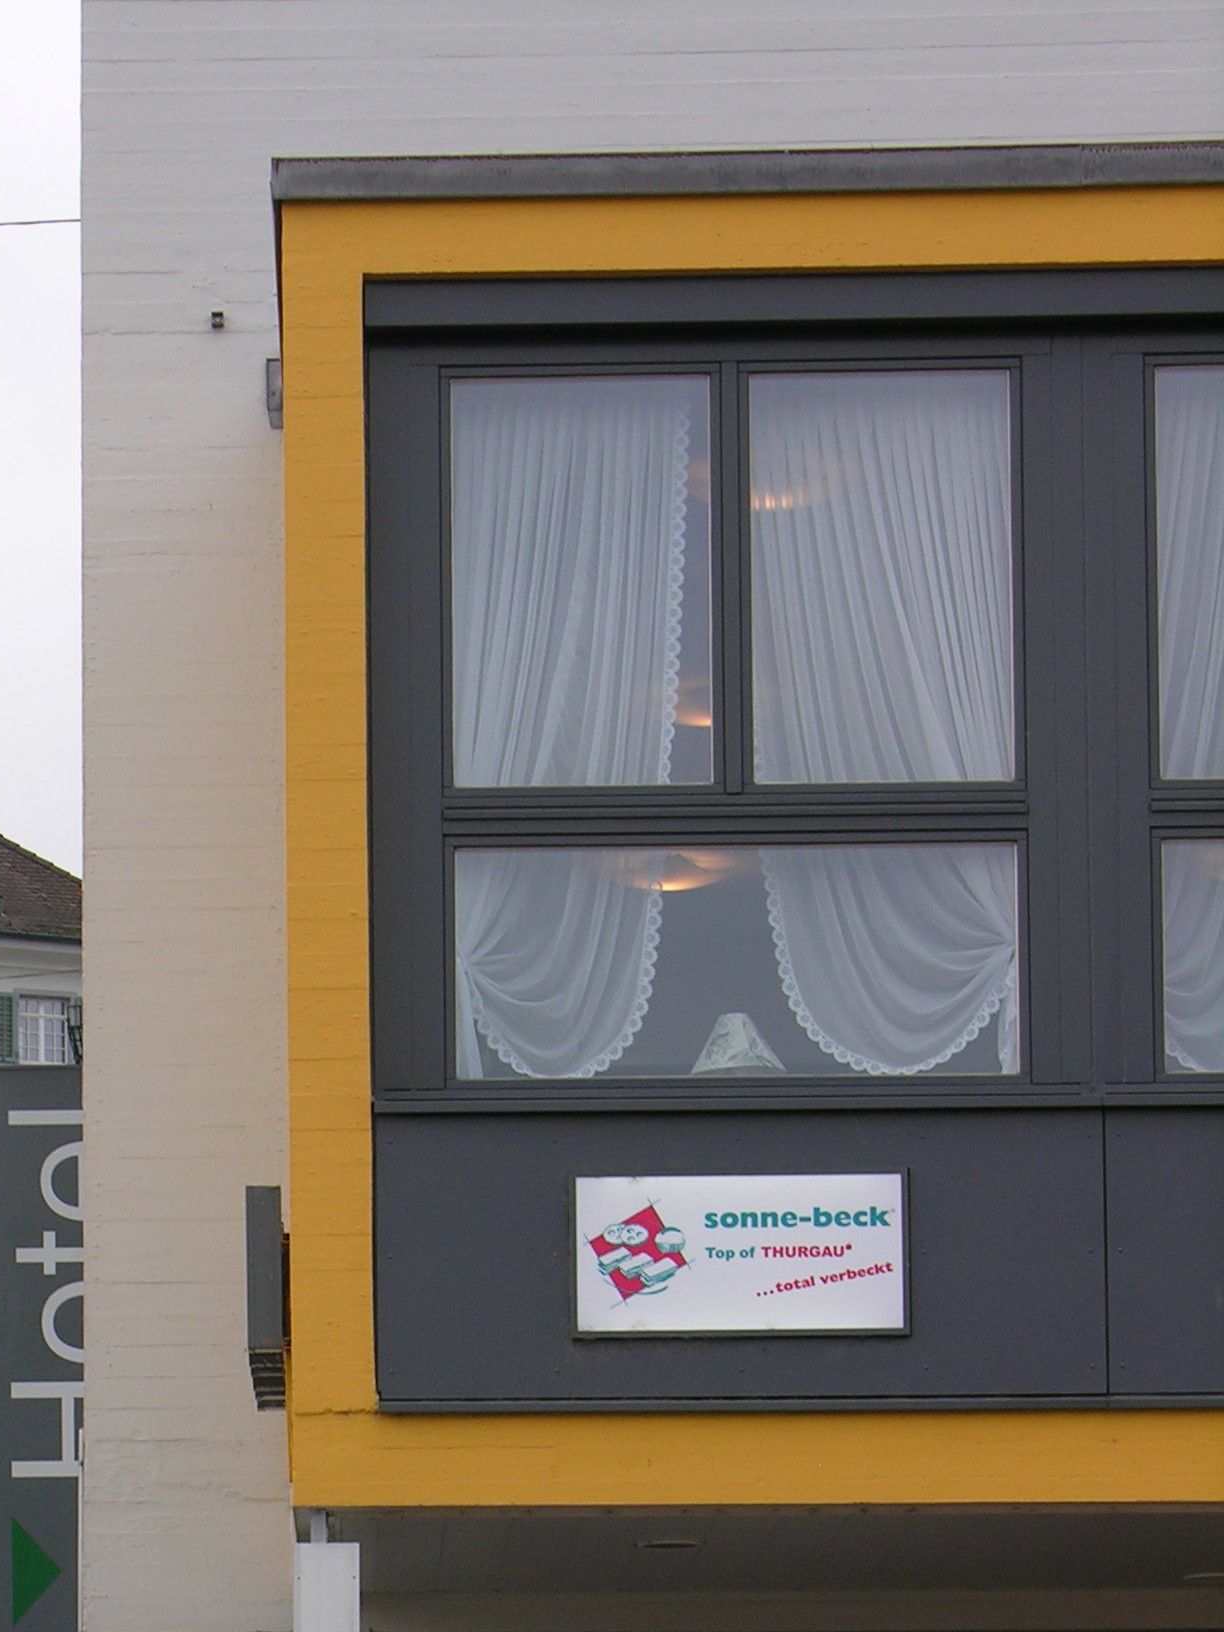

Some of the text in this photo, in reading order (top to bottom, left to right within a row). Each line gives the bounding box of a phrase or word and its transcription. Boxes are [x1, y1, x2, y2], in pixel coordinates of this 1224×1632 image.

[704, 1206, 891, 1229] sonne-beck
[705, 1246, 735, 1262] Top
[739, 1245, 756, 1260] of
[820, 1260, 894, 1285] verbeckt
[8, 1109, 83, 1478] Hotel
